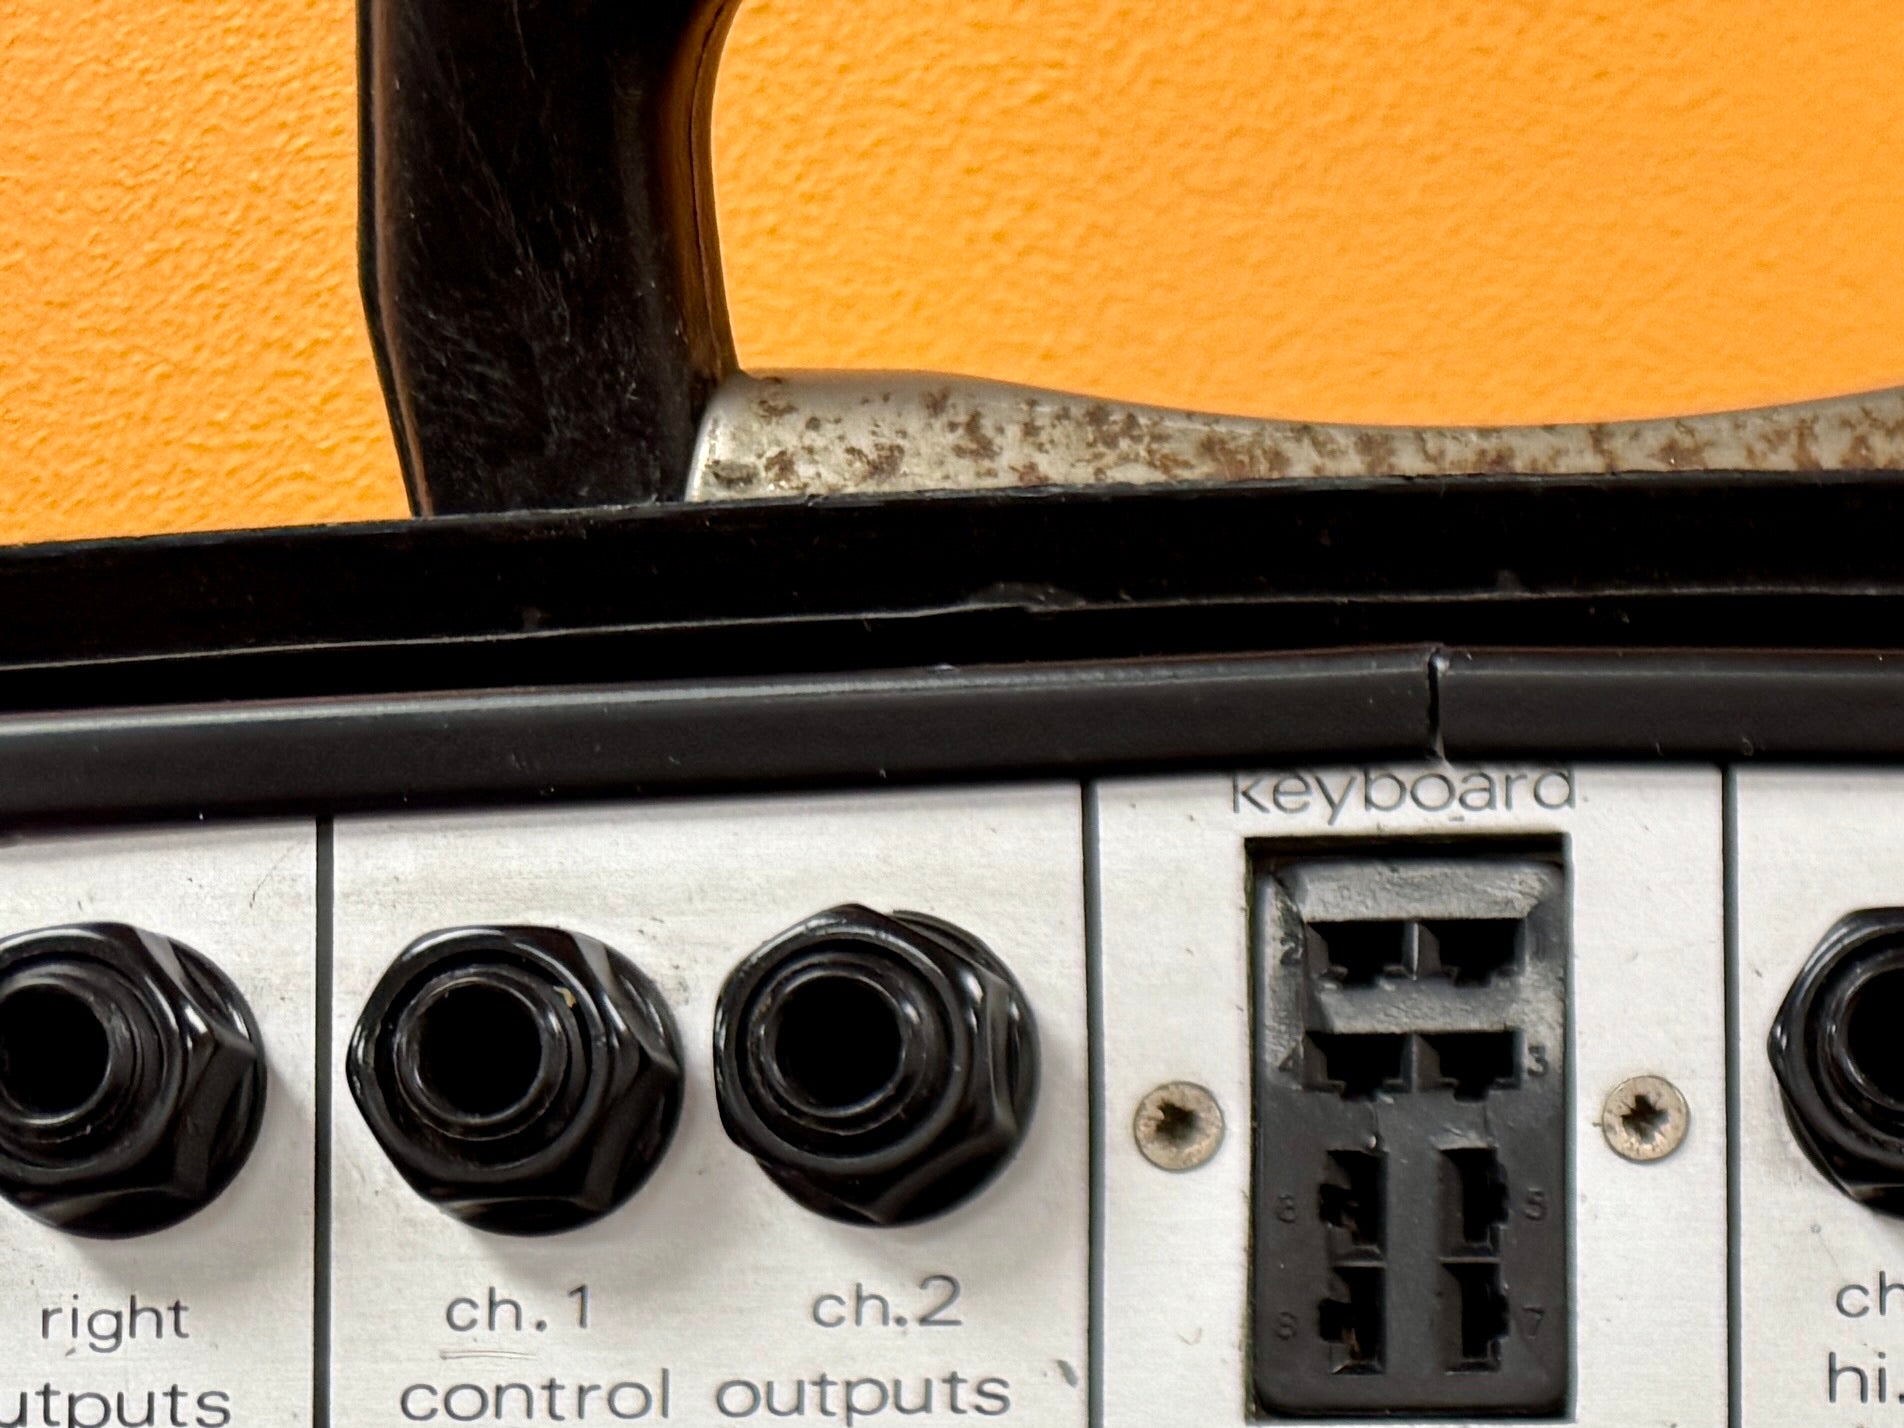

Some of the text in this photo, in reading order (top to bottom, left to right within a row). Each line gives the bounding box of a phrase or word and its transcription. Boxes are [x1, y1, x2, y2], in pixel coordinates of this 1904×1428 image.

[1232, 768, 1576, 826] keyboard
[42, 1294, 189, 1353] right
[399, 1368, 1011, 1428] control outputs
